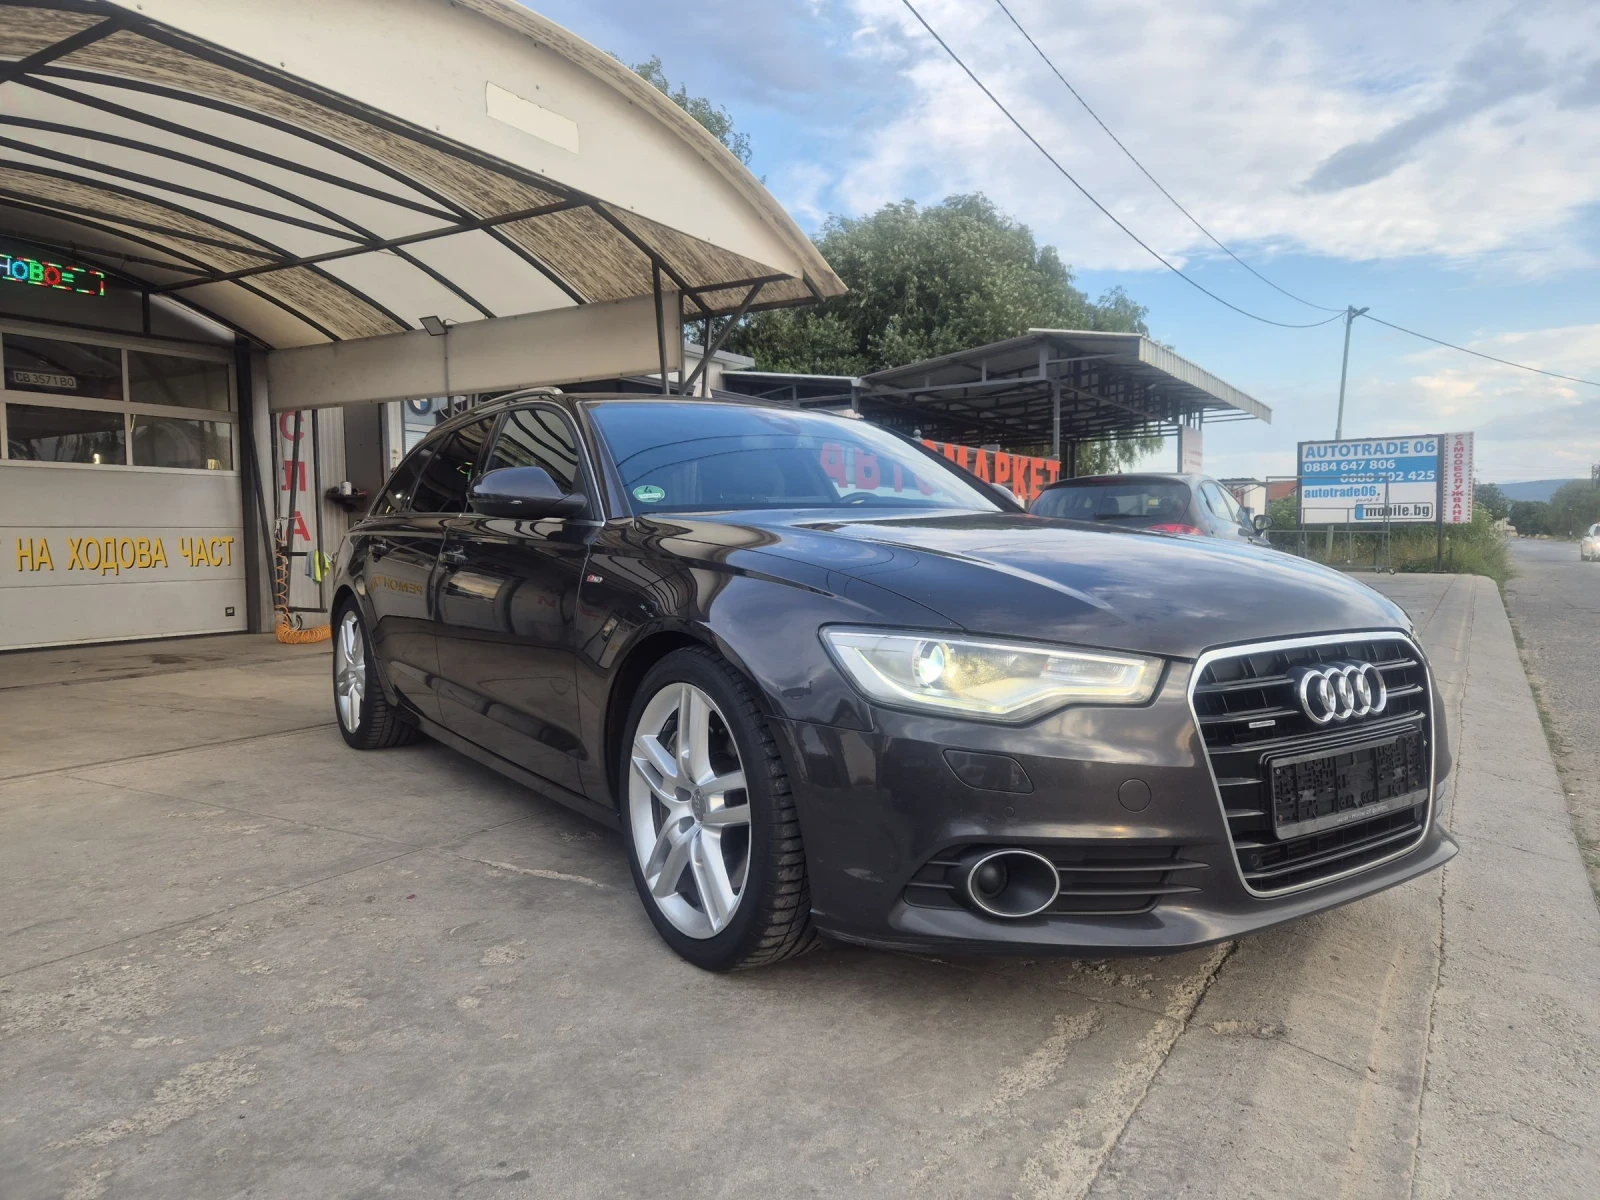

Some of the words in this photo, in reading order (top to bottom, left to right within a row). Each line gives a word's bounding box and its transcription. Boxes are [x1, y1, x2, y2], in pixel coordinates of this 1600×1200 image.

[15, 372, 31, 383] CB
[32, 374, 58, 385] 3571
[1305, 442, 1409, 459] AUTOTRADE
[1413, 440, 1436, 454] 06
[1304, 462, 1337, 473] 0884
[1340, 461, 1366, 471] 647
[1369, 459, 1396, 470] 806
[1407, 470, 1435, 481] 425
[1452, 434, 1465, 522] САМООБСЛУЖВАНЕ
[16, 537, 54, 572] НА
[67, 536, 169, 577] ХОДОВА
[179, 536, 235, 567] ЧАСТ
